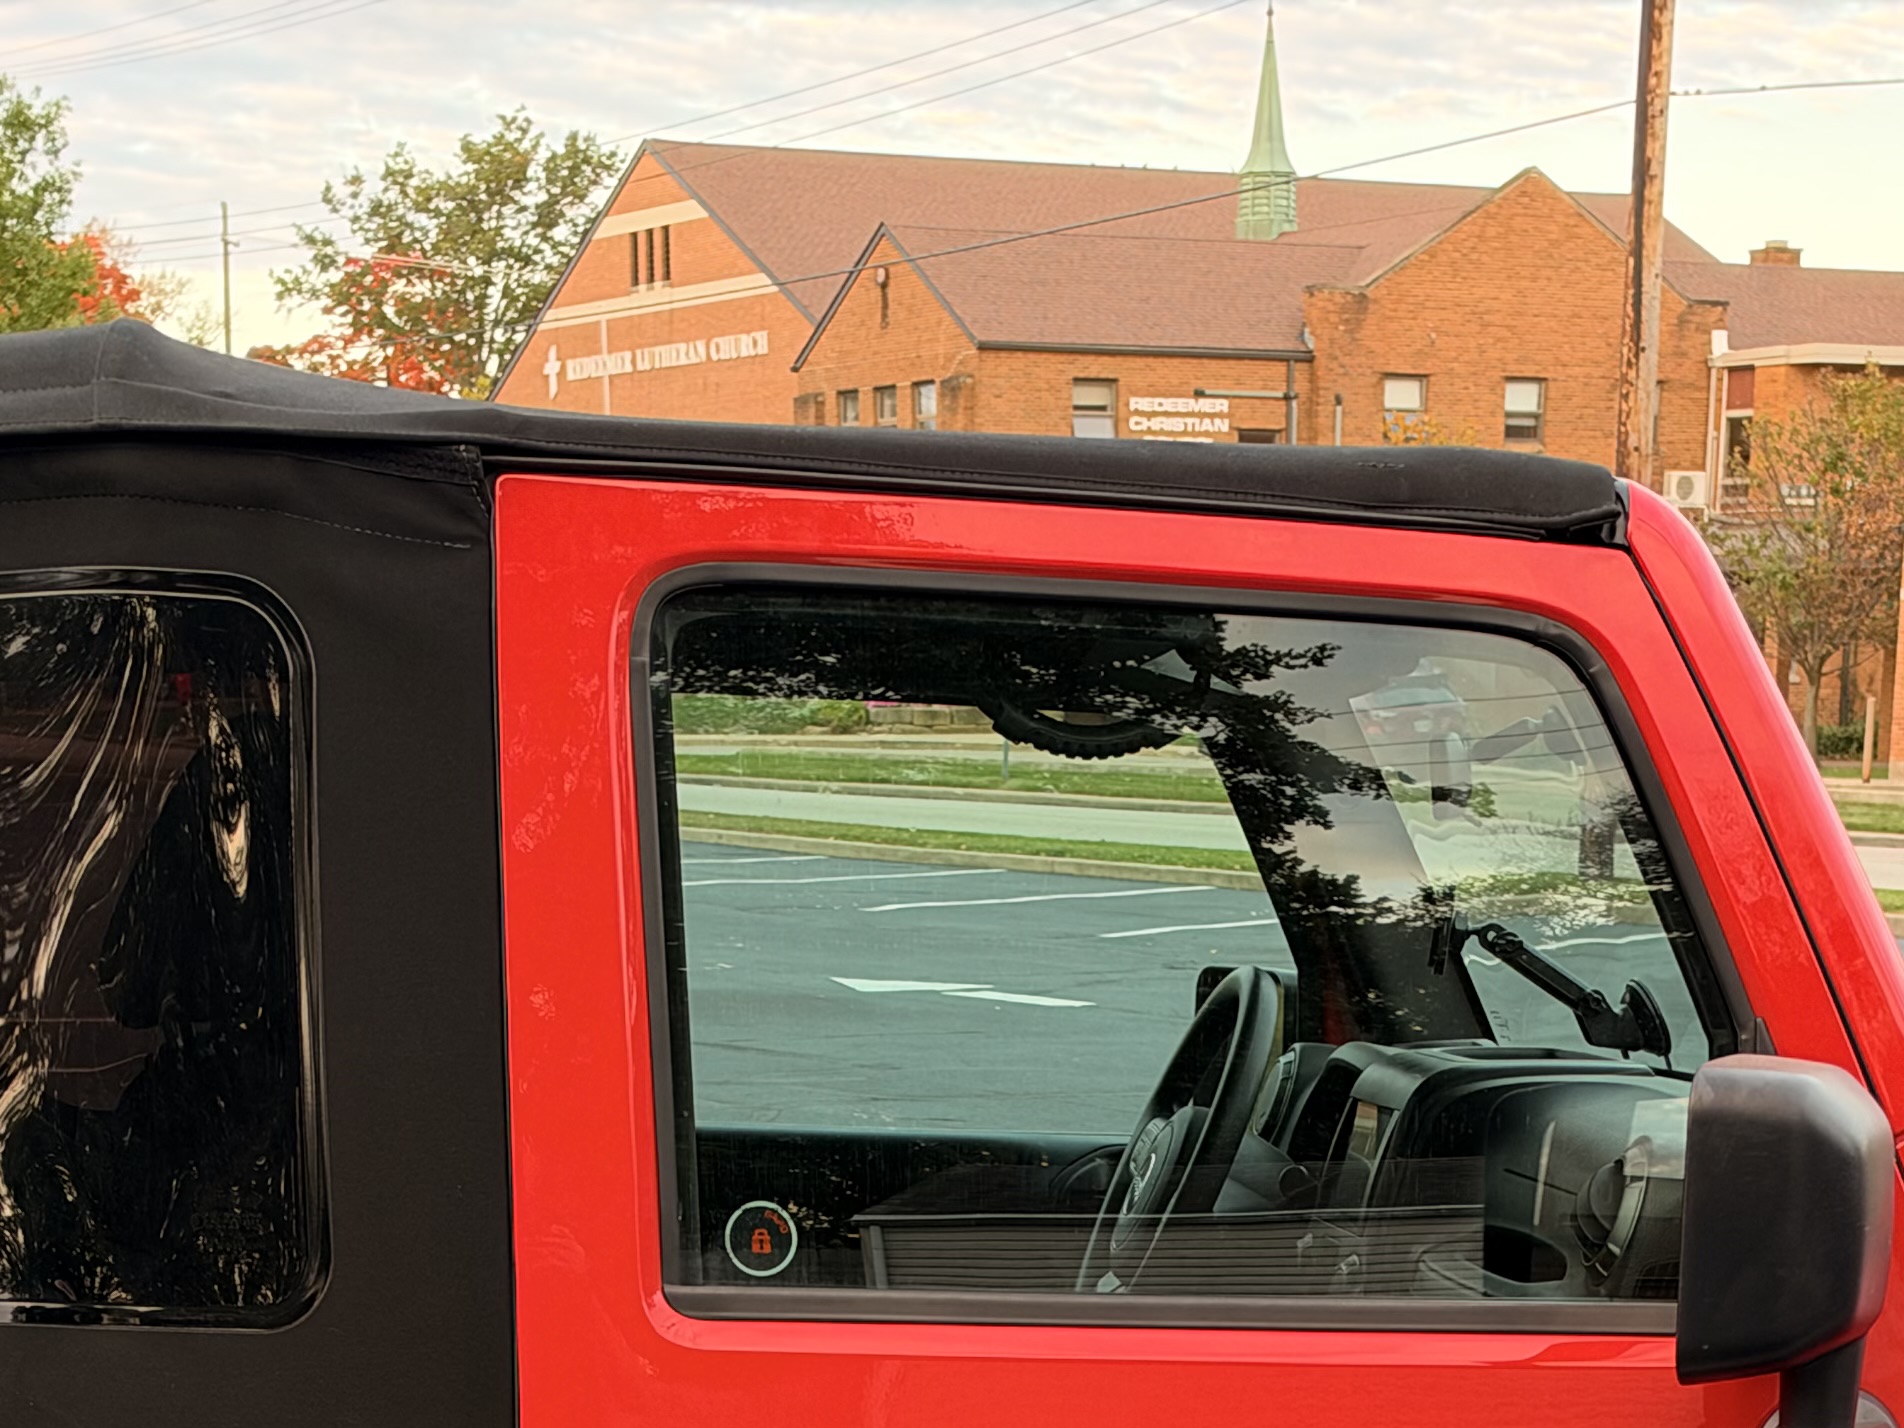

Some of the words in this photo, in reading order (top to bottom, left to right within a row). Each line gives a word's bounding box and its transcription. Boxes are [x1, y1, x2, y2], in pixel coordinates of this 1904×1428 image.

[636, 339, 707, 371] LUTHERAN
[710, 330, 769, 361] CHURCH
[1129, 397, 1229, 413] REDEEMER
[1129, 416, 1229, 432] CHRISTIAN
